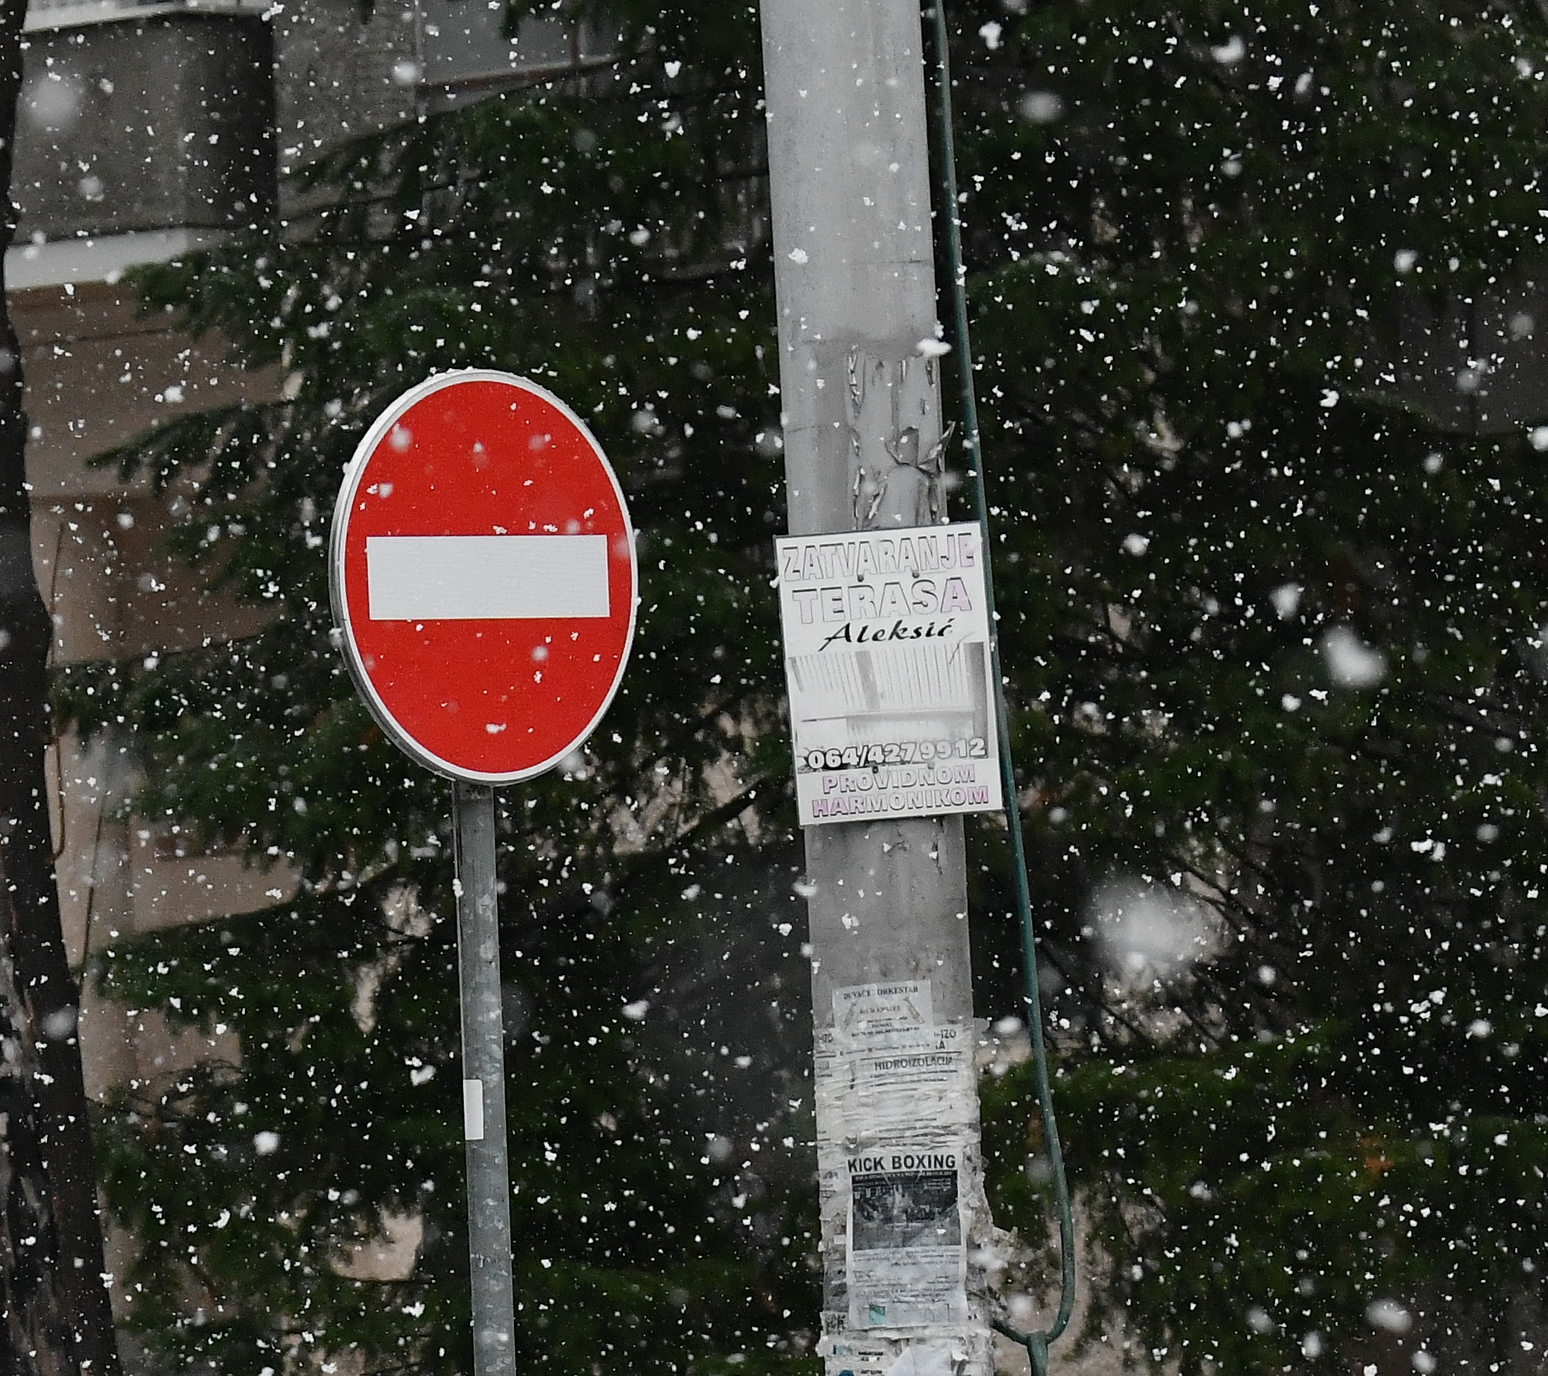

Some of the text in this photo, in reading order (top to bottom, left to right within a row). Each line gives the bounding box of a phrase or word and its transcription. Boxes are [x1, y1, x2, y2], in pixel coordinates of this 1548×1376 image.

[782, 532, 976, 582] ZATVARANJE
[792, 577, 973, 624] TERASA
[818, 617, 955, 652] Aleksić
[822, 764, 977, 795] PROVIDNOM
[811, 786, 990, 819] HARMONIKOM
[874, 1056, 954, 1071] HIDROIZOLACIJA
[848, 1154, 956, 1173] KICK BOXING
